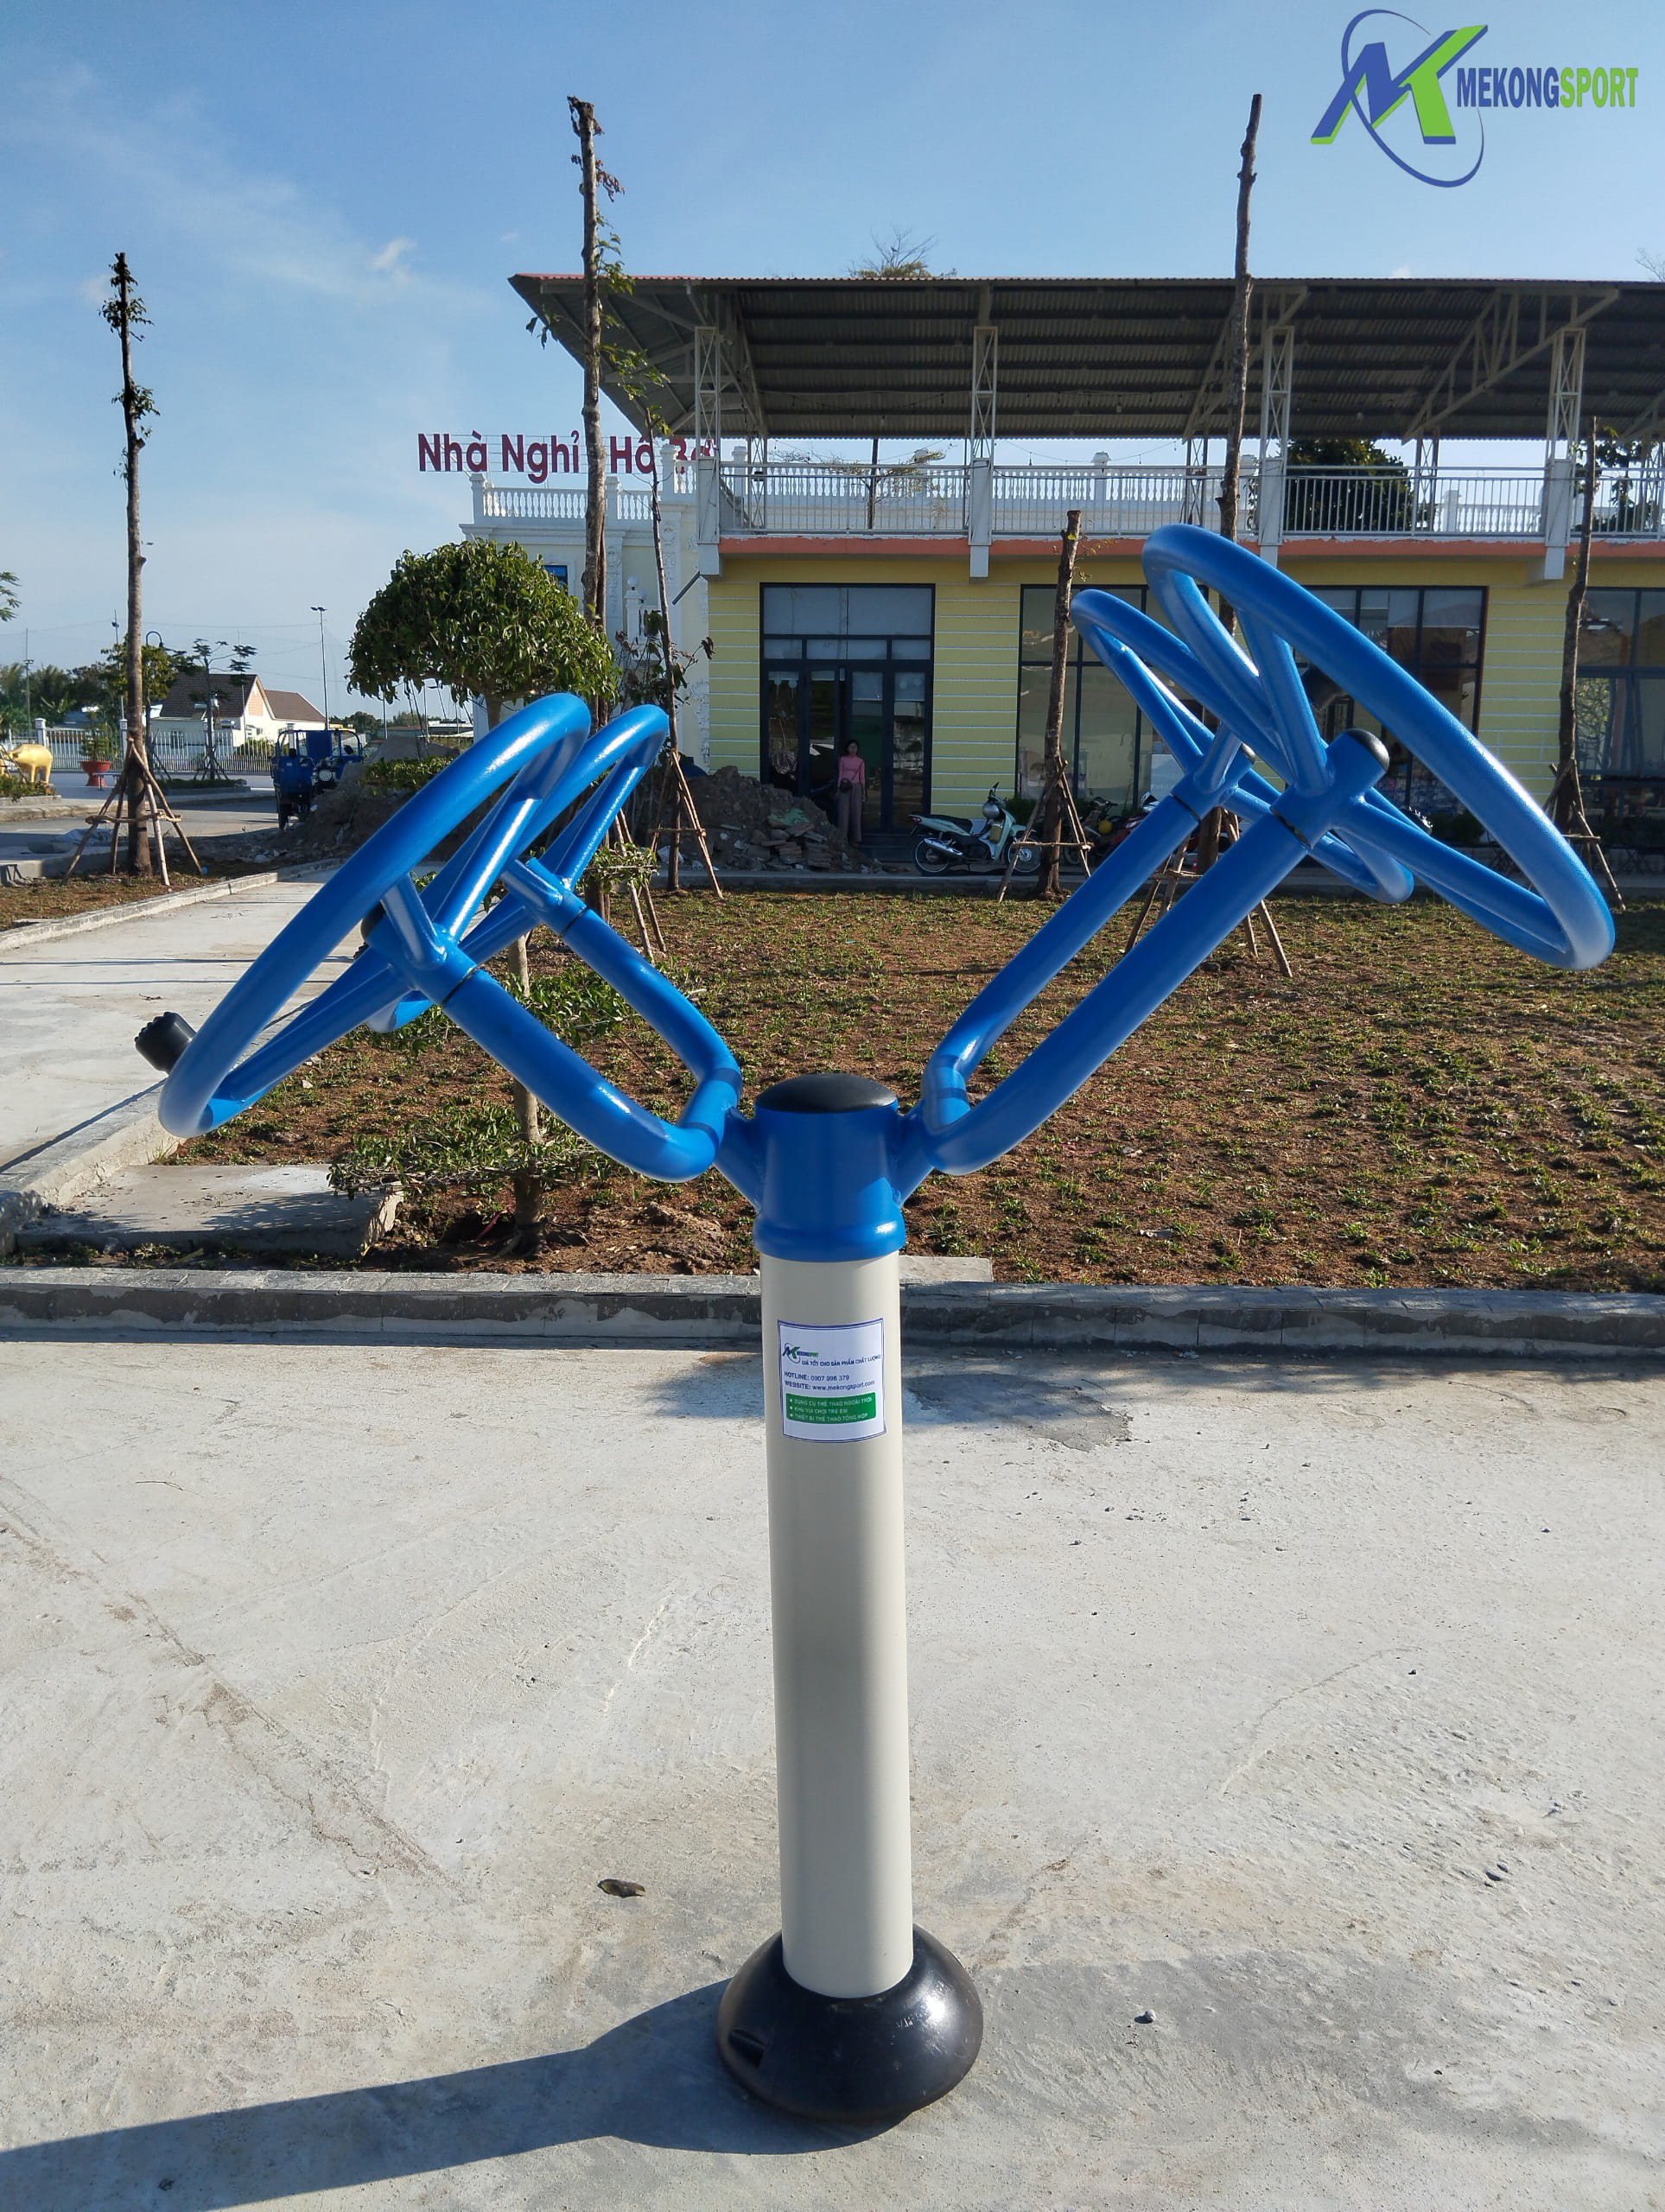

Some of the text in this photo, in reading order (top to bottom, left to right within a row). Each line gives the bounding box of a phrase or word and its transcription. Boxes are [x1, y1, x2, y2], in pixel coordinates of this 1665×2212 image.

[418, 430, 487, 473] Nhà
[502, 429, 580, 484] Nghỉ
[785, 1371, 809, 1381] HOTLINE:
[785, 1380, 875, 1390] WEBSITE: www.mekongsport.com
